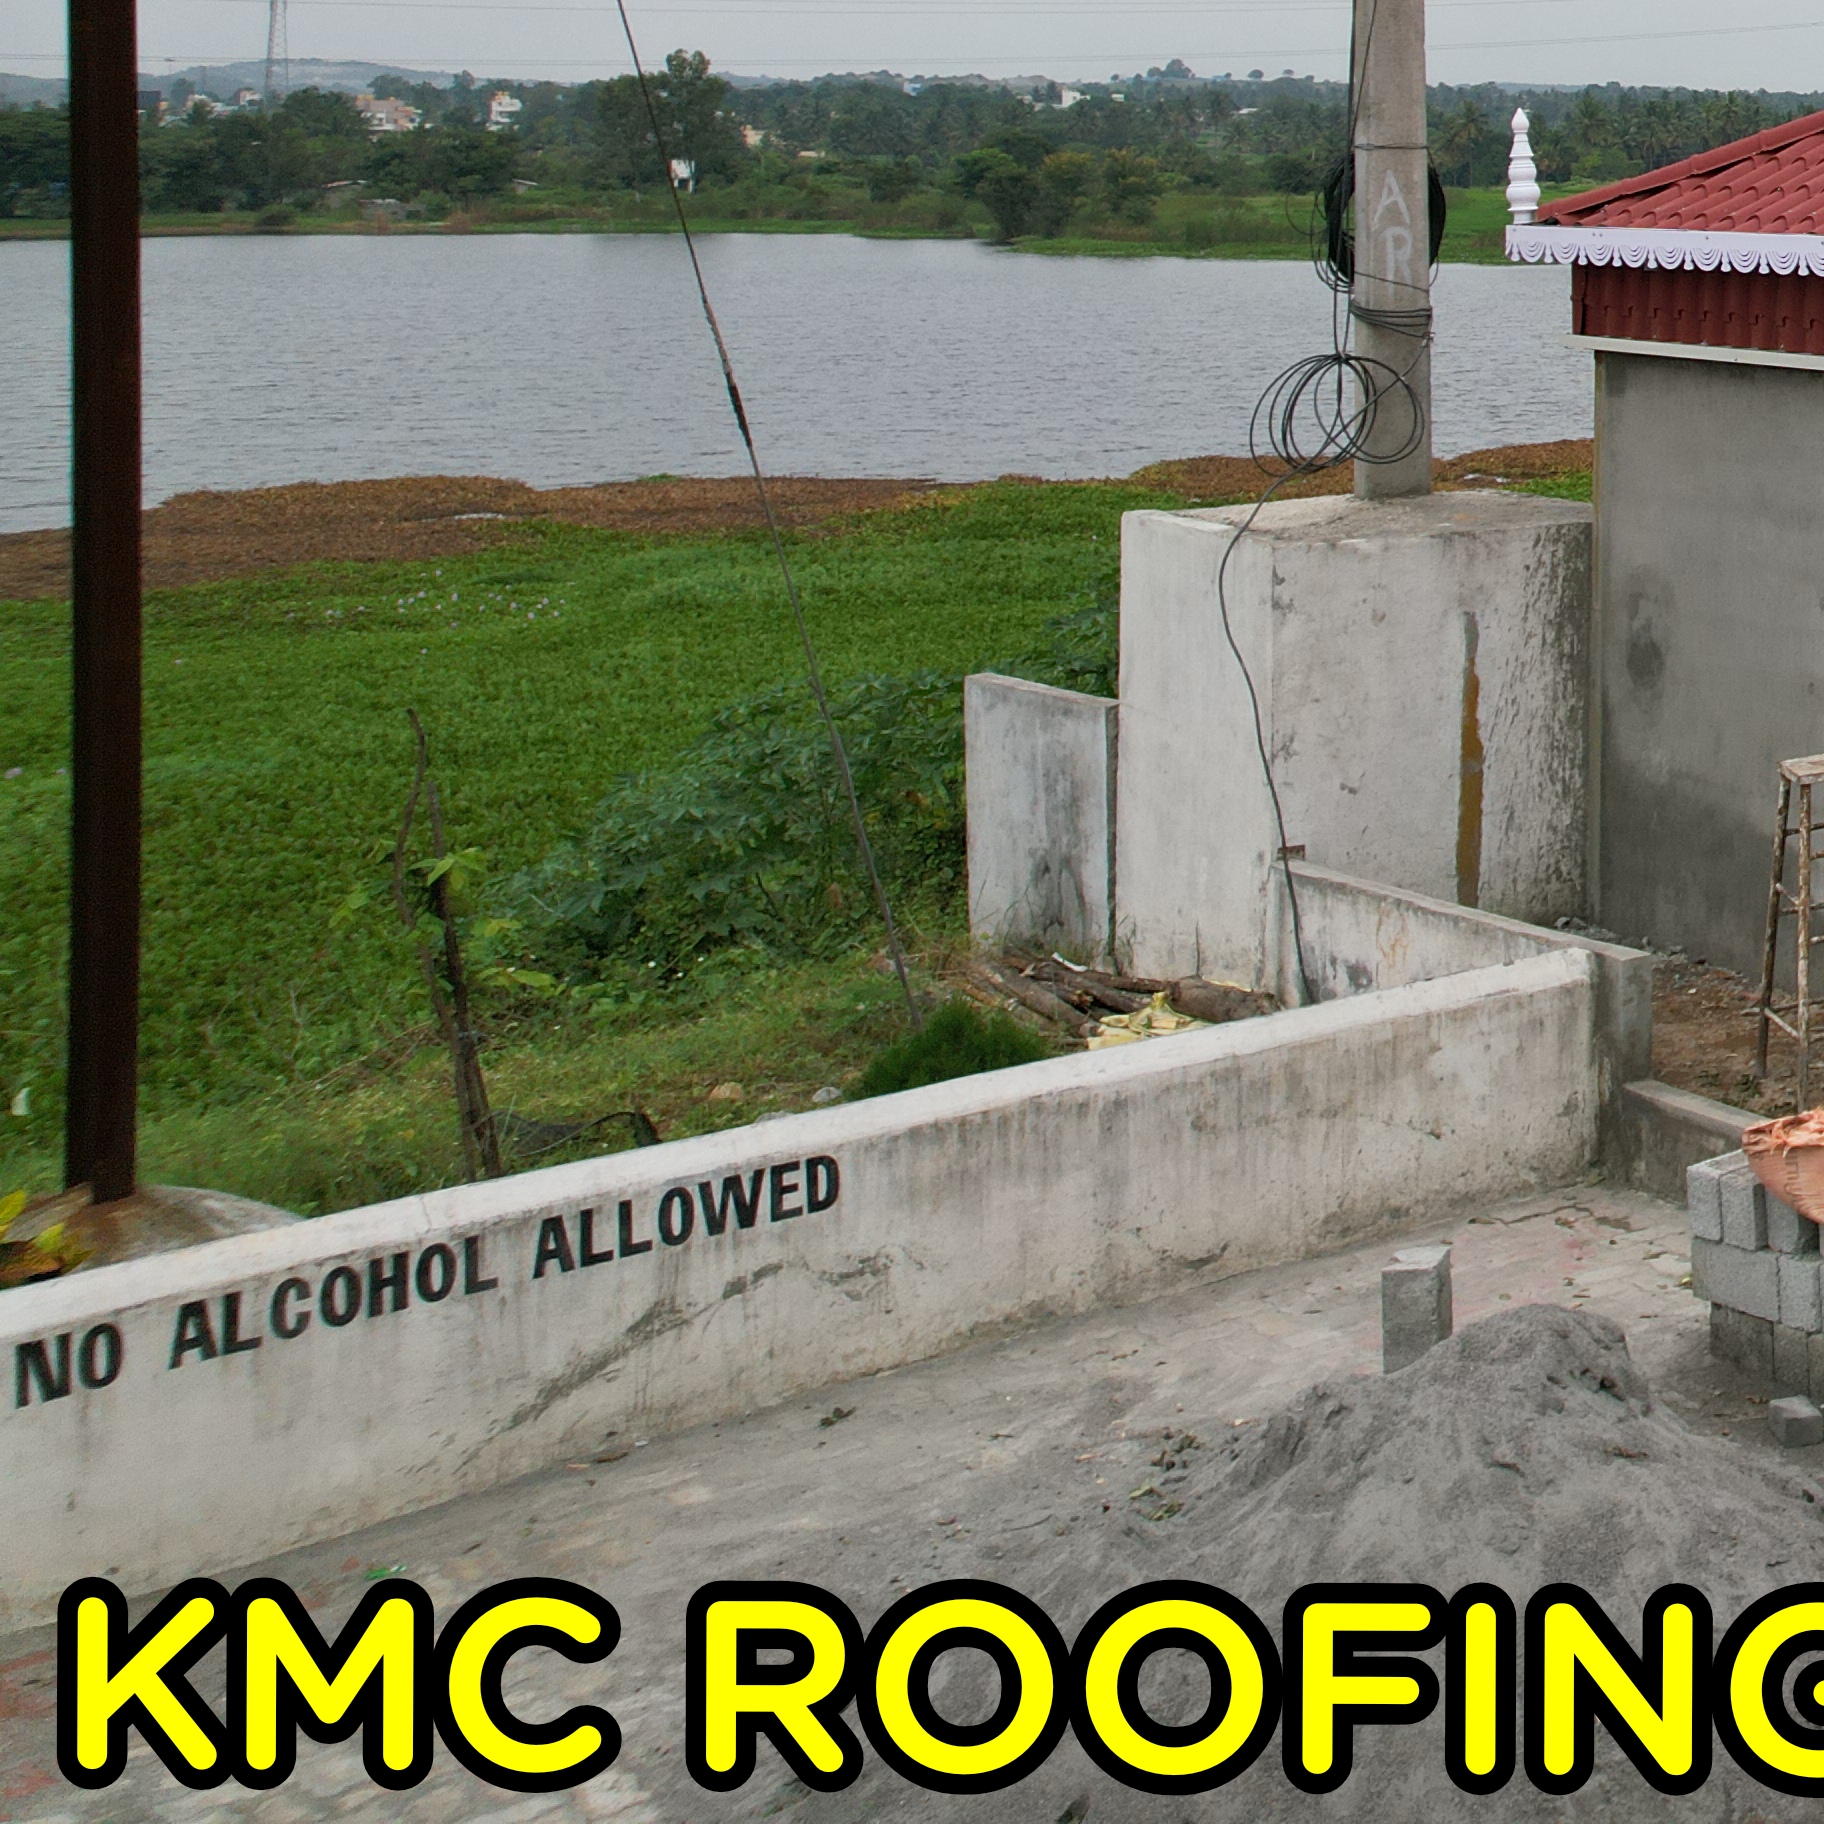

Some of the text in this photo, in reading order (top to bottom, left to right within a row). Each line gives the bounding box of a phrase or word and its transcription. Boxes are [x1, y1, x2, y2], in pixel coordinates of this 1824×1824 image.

[14, 1154, 842, 1409] NO ALCOHOL ALLOWED
